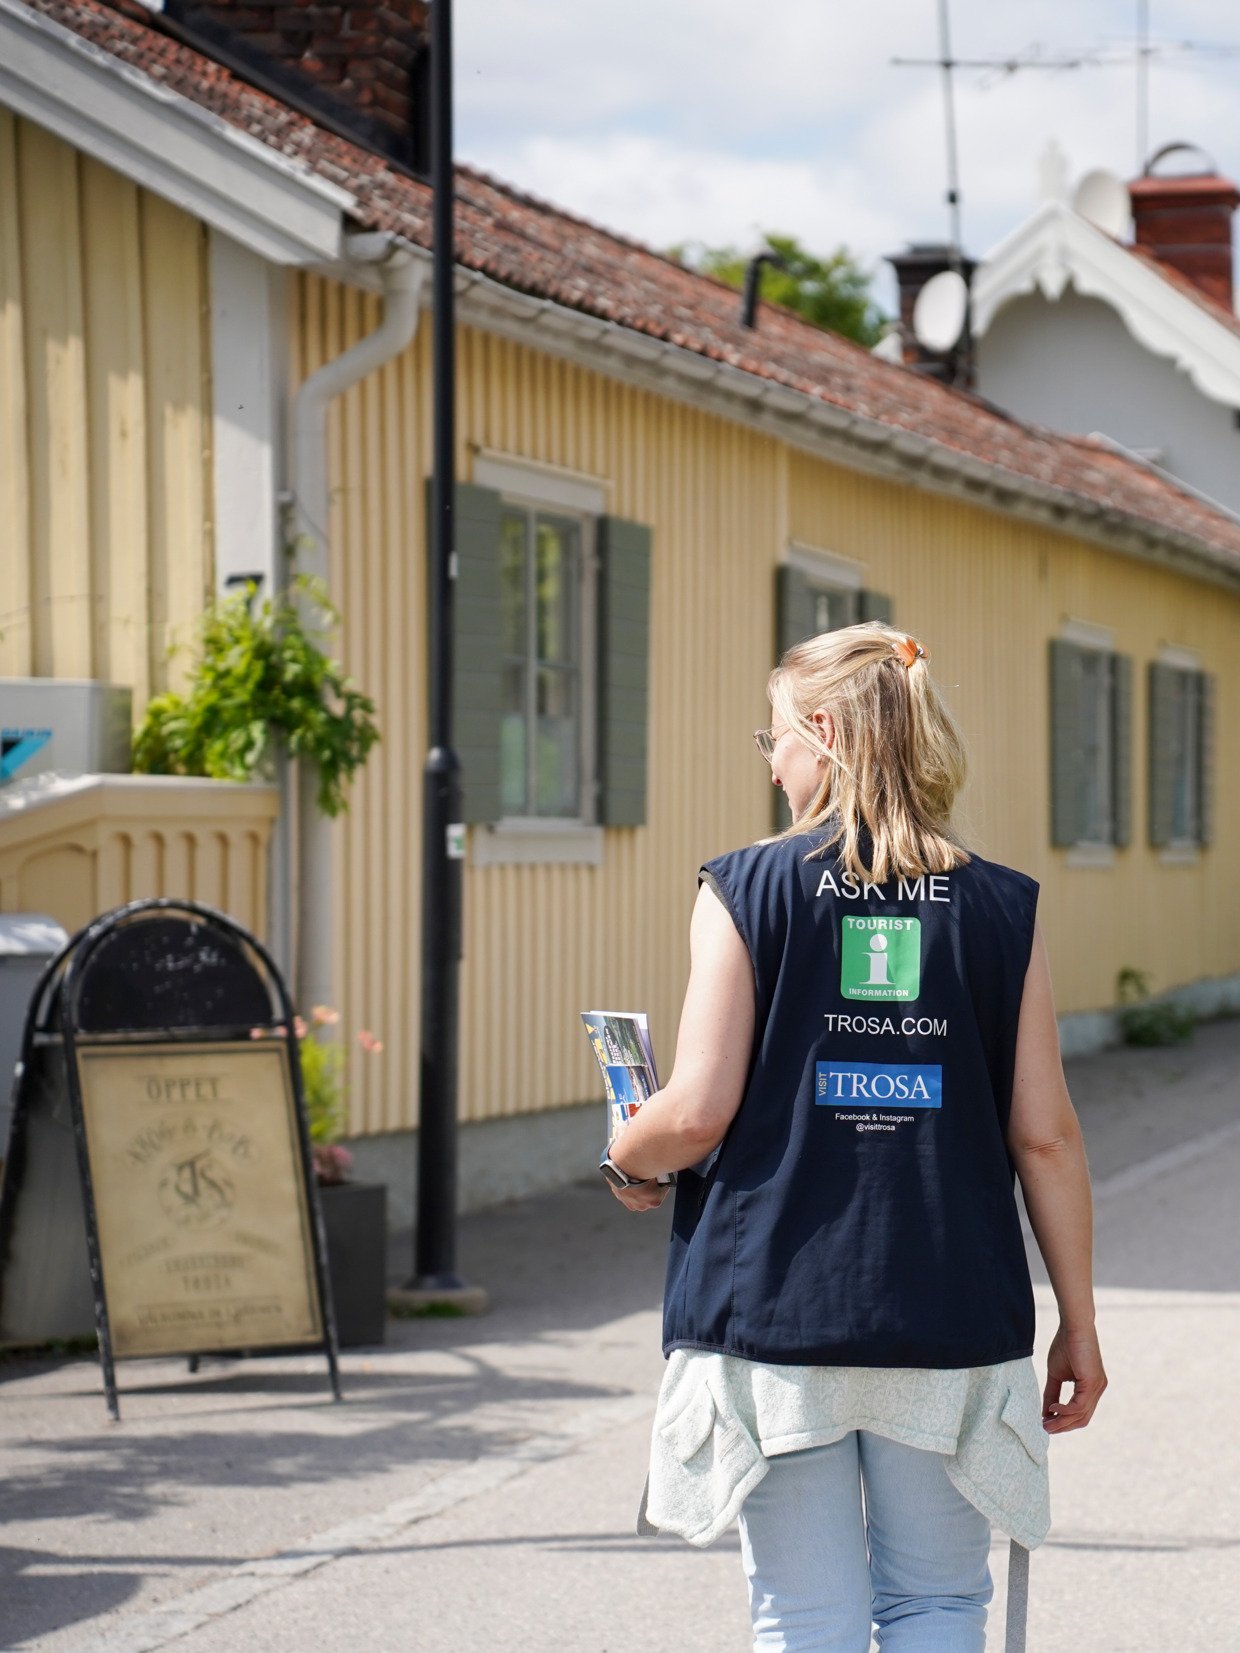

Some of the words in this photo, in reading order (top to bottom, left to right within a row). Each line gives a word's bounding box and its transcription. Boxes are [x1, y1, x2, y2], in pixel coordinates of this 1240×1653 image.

[816, 870, 886, 900] ASK
[898, 874, 950, 902] ME
[847, 918, 914, 931] TOURIST
[848, 988, 909, 997] INFORMATION
[824, 1014, 947, 1036] TROSA.COM
[818, 1072, 827, 1096] VISIT
[829, 1072, 932, 1099] TROSA
[835, 1112, 871, 1121] Facebook
[879, 1114, 915, 1123] Instagram
[855, 1123, 896, 1132] @visittrosa
